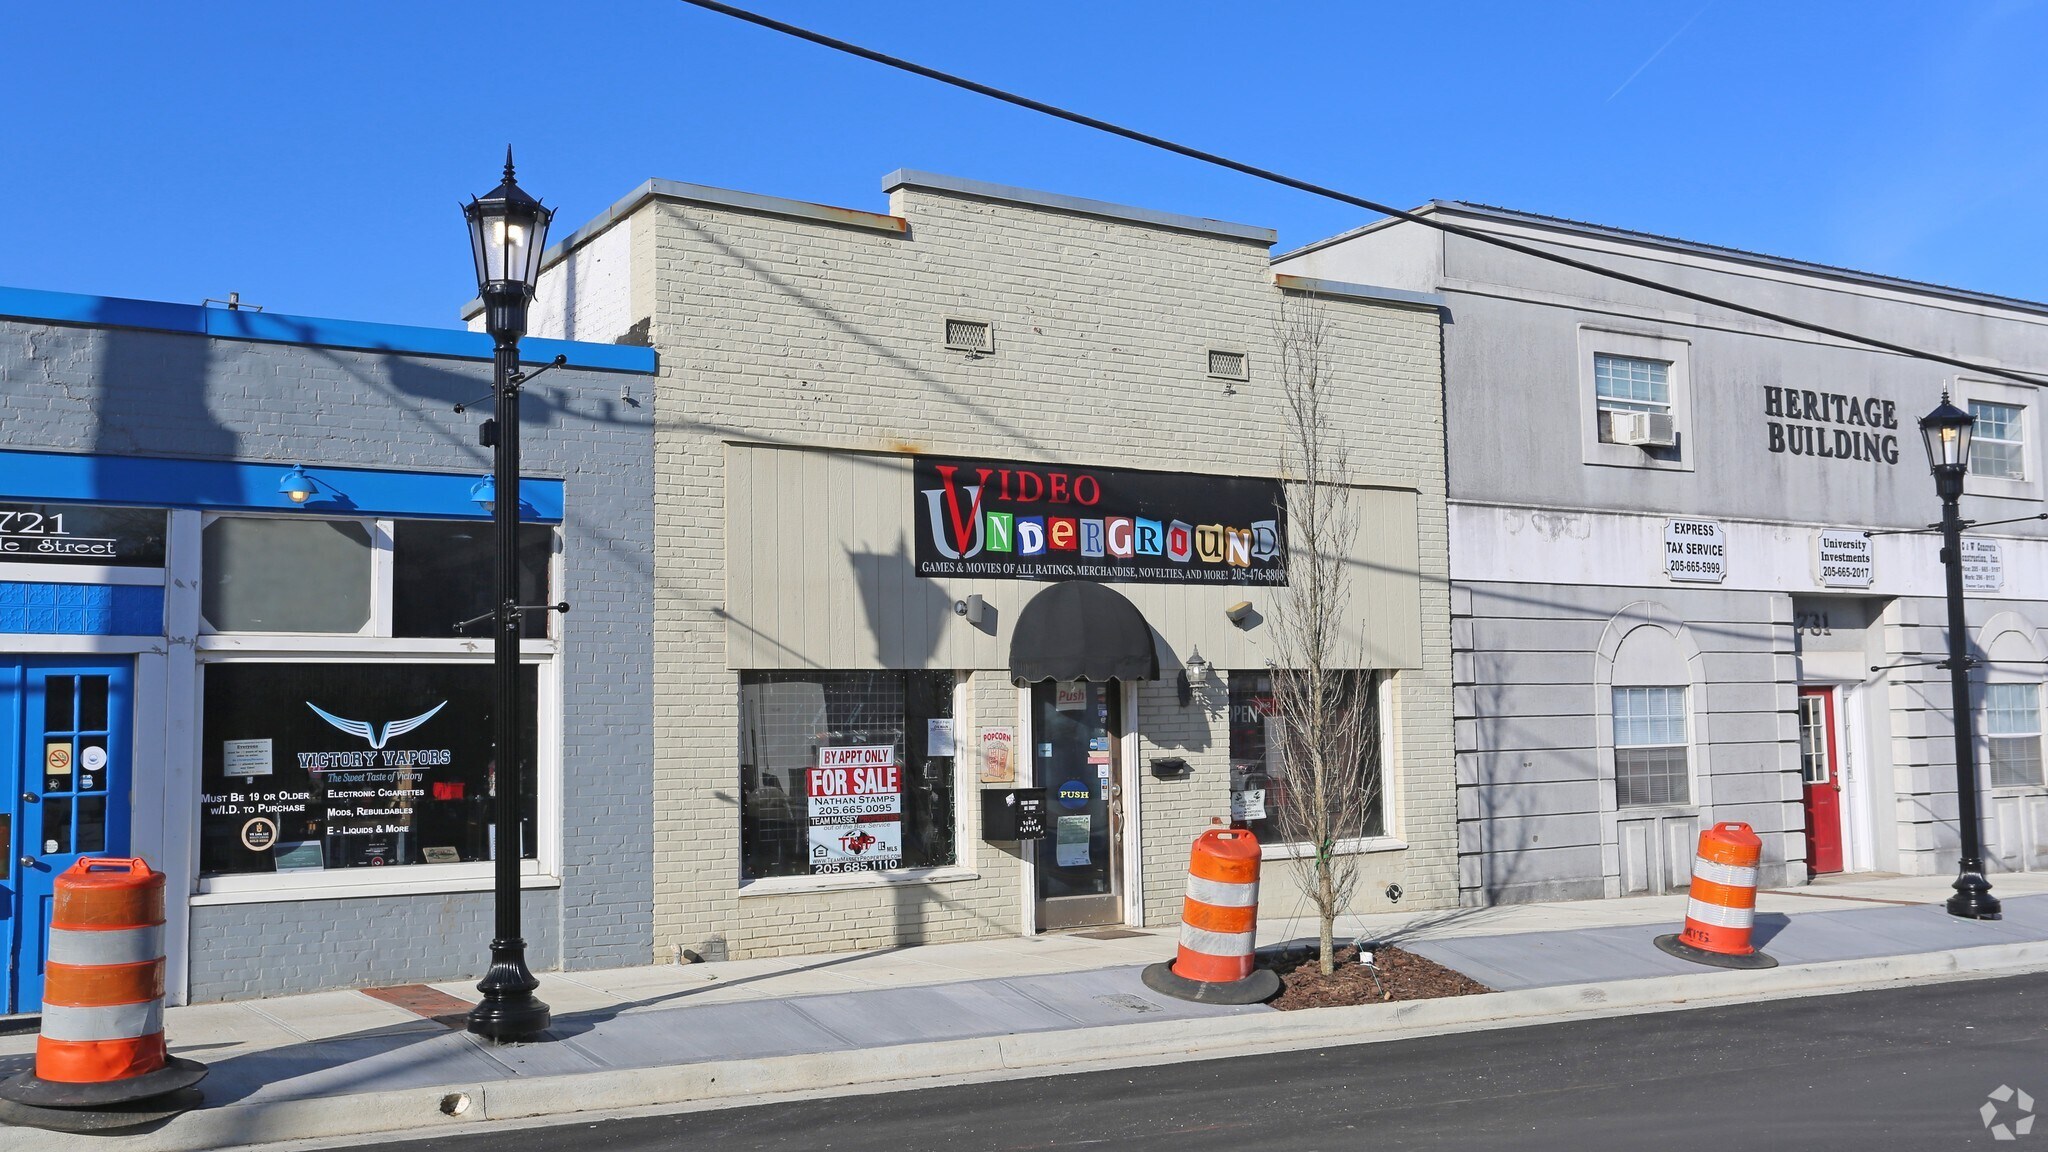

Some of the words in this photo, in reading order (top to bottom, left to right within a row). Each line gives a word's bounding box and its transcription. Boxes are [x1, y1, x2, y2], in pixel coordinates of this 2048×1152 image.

[1764, 385, 1898, 430] HERITAGE
[1767, 422, 1899, 465] BUILDING
[936, 465, 1099, 556] VIDEO
[0, 511, 70, 535] 721
[1674, 522, 1714, 536] EXPRESS
[38, 539, 116, 554] Street
[1666, 541, 1684, 554] TAX
[1686, 543, 1723, 556] SERVICE
[1823, 538, 1867, 552] University
[1821, 551, 1870, 563] Investments
[922, 562, 954, 573] GAMES
[957, 563, 965, 573] &
[966, 562, 1001, 574] MOVIES
[1003, 563, 1015, 574] OF
[1016, 564, 1034, 576] ALL
[1036, 564, 1076, 577] RATINGS,
[1077, 565, 1138, 579] MERCHANDISE,
[1139, 567, 1184, 581] NOVELTIES,
[1184, 569, 1201, 580] AND
[1203, 570, 1228, 581] MORE!
[1671, 559, 1720, 574] 205-665-5999
[1823, 566, 1869, 578] 205-665-2017
[1796, 610, 1832, 637] 731
[1058, 690, 1085, 702] Push
[984, 732, 1011, 742] POPCORN
[298, 751, 377, 769] VICTORY
[382, 749, 451, 766] VAPORS
[825, 751, 837, 764] BY
[838, 750, 863, 763] APPT
[865, 749, 889, 763] ONLY
[328, 773, 341, 783] The
[342, 772, 364, 783] Sweet
[366, 771, 385, 782] Taste
[386, 771, 396, 783] of
[397, 770, 423, 783] Victory
[811, 770, 848, 796] FOR
[853, 767, 898, 794] SALE
[201, 794, 228, 804] MUST
[230, 792, 245, 803] BE
[249, 792, 260, 802] 19
[279, 790, 310, 801] OLDER
[328, 788, 375, 798] ELECTRONIC
[378, 787, 424, 798] CIGARETTES
[1060, 791, 1090, 799] PUSH
[815, 797, 856, 806] NATHAN
[858, 794, 896, 804] STAMPS
[258, 803, 306, 813] PURCHASE
[328, 807, 355, 818] MODS,
[357, 806, 414, 816] REBUILDABLES
[819, 804, 892, 815] 205.665.0095
[811, 816, 832, 826] TEAM
[832, 815, 858, 825] MASSEY
[868, 820, 891, 829] Service
[327, 826, 334, 835] E
[342, 825, 374, 836] LIQUIDS
[375, 825, 384, 835] &
[385, 823, 410, 834] MORE
[815, 859, 898, 874] 205.685.1110
